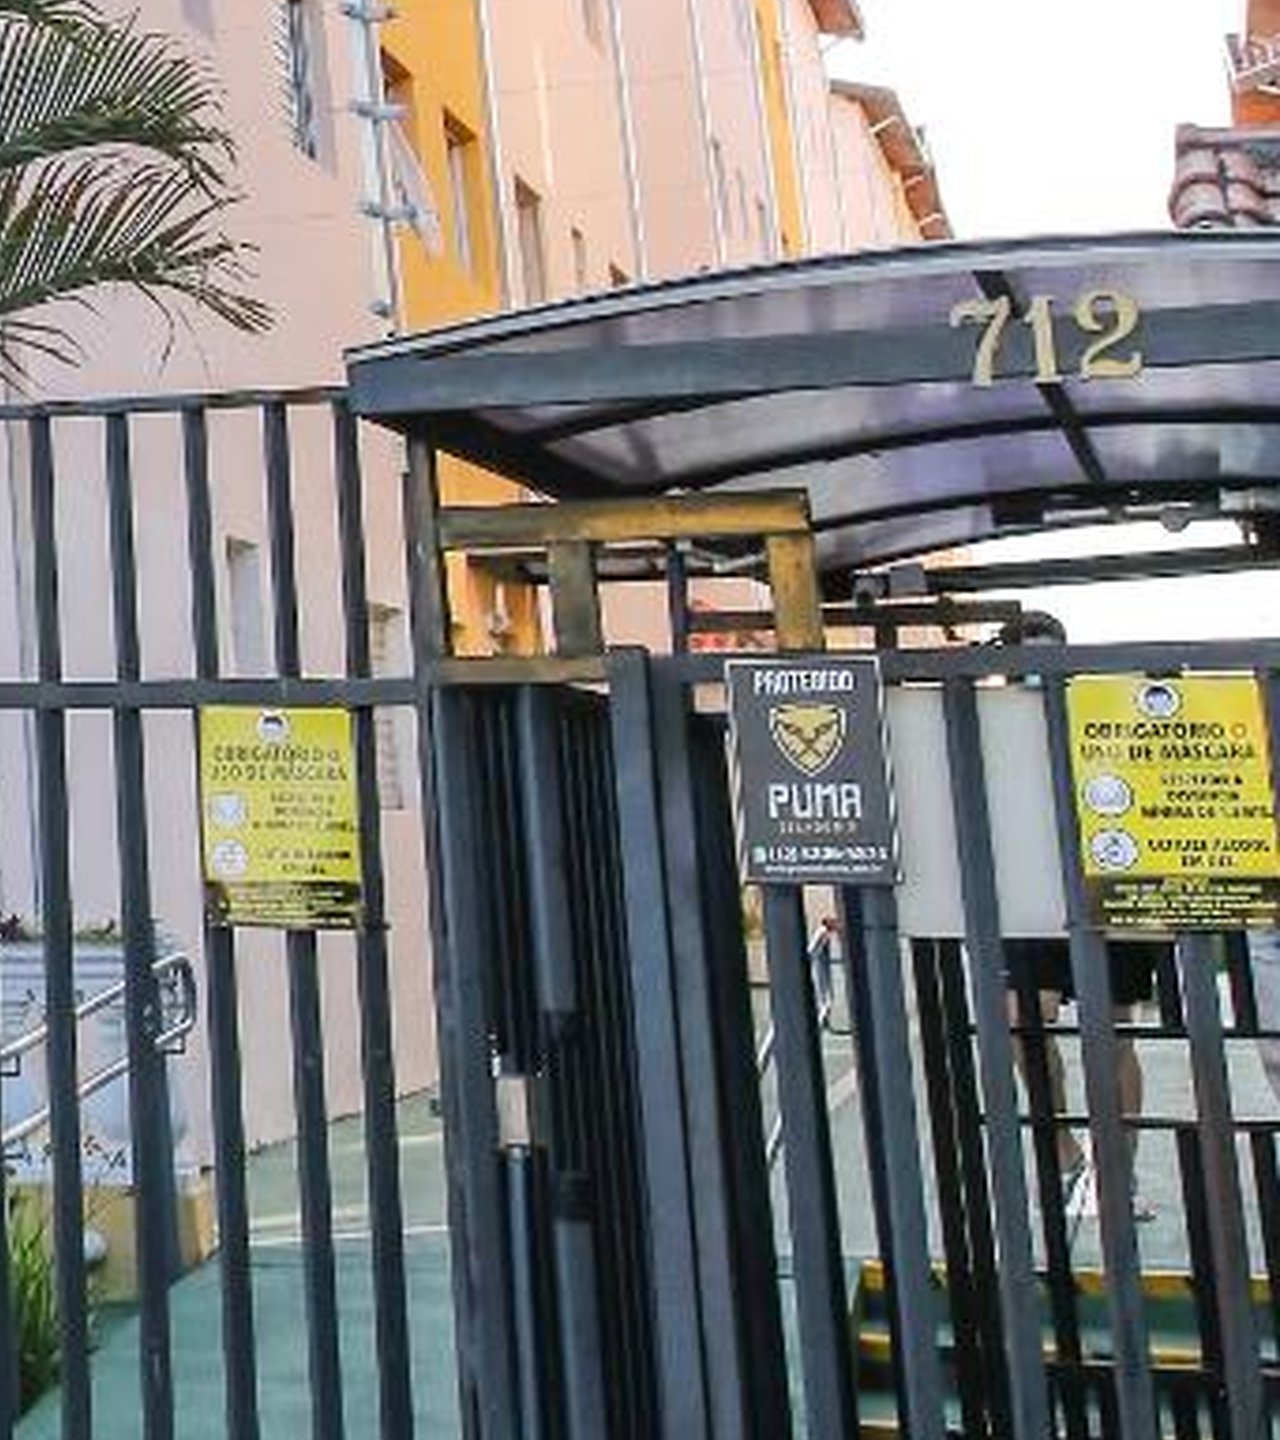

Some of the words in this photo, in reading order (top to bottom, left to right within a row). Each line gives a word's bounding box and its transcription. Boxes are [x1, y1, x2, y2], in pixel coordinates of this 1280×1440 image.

[949, 289, 1142, 387] 712
[753, 669, 854, 695] PROTEGIDO
[1230, 722, 1248, 739] O
[768, 783, 863, 819] PUMA
